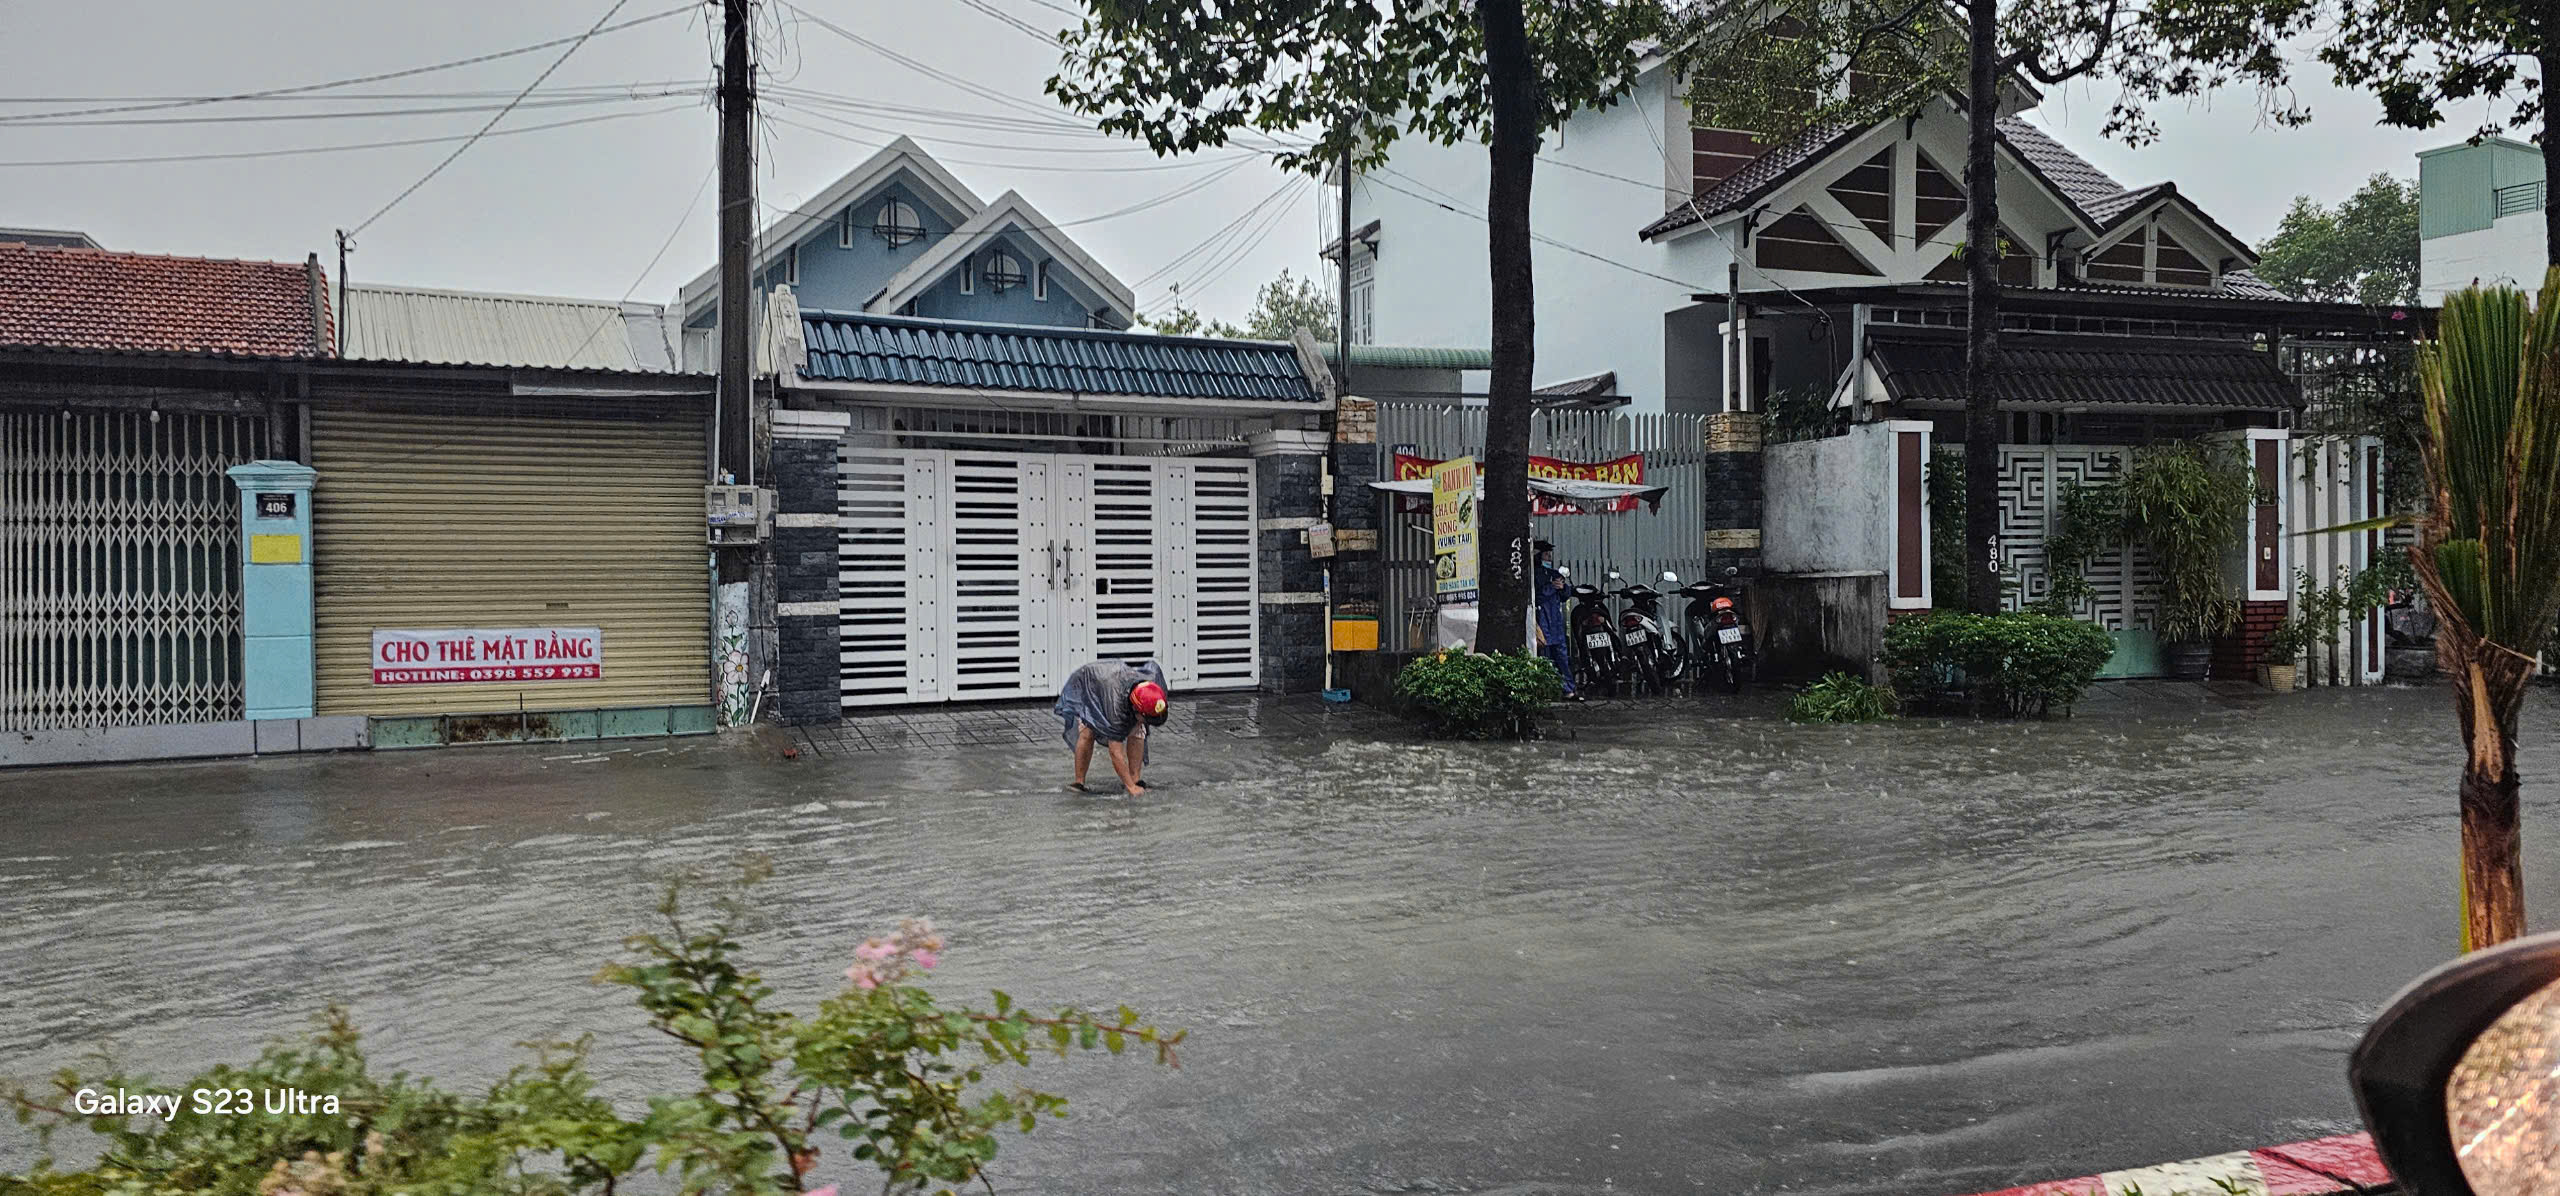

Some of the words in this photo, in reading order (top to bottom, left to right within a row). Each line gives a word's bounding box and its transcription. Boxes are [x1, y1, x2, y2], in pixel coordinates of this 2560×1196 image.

[265, 502, 288, 513] 406
[1511, 536, 1522, 580] 482
[1988, 534, 1998, 573] 480
[380, 641, 430, 662] CHO
[436, 636, 477, 661] THÊ
[483, 635, 528, 665] MẶT
[534, 630, 593, 659] BẰNG
[381, 669, 465, 682] HOTLINE:
[471, 668, 517, 680] 0398
[522, 667, 555, 679] 559
[562, 666, 594, 678] 995
